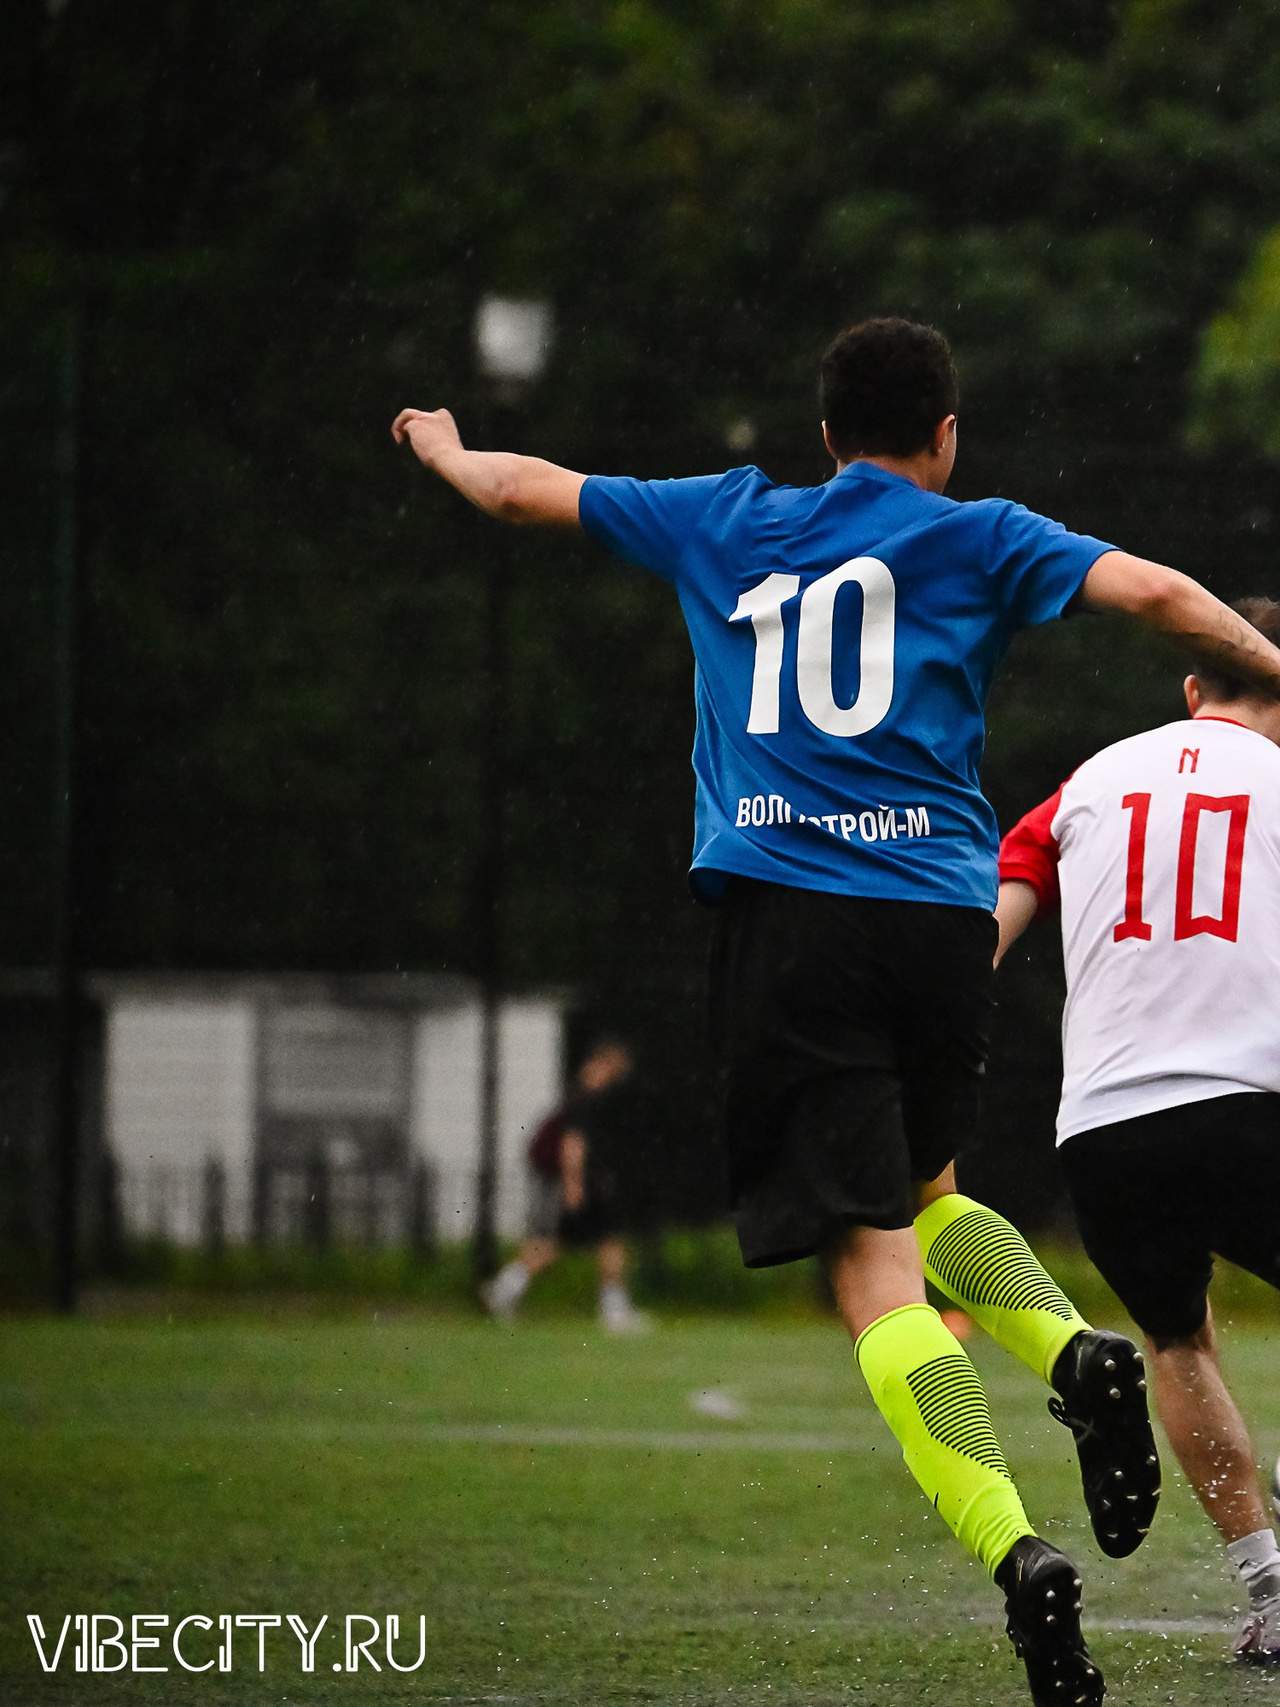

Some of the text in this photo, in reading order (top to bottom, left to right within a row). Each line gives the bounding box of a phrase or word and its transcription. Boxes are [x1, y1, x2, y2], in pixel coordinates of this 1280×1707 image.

[728, 556, 896, 737] 10
[735, 794, 931, 842] ВОЛТРОЙ-М
[1113, 792, 1251, 943] 10
